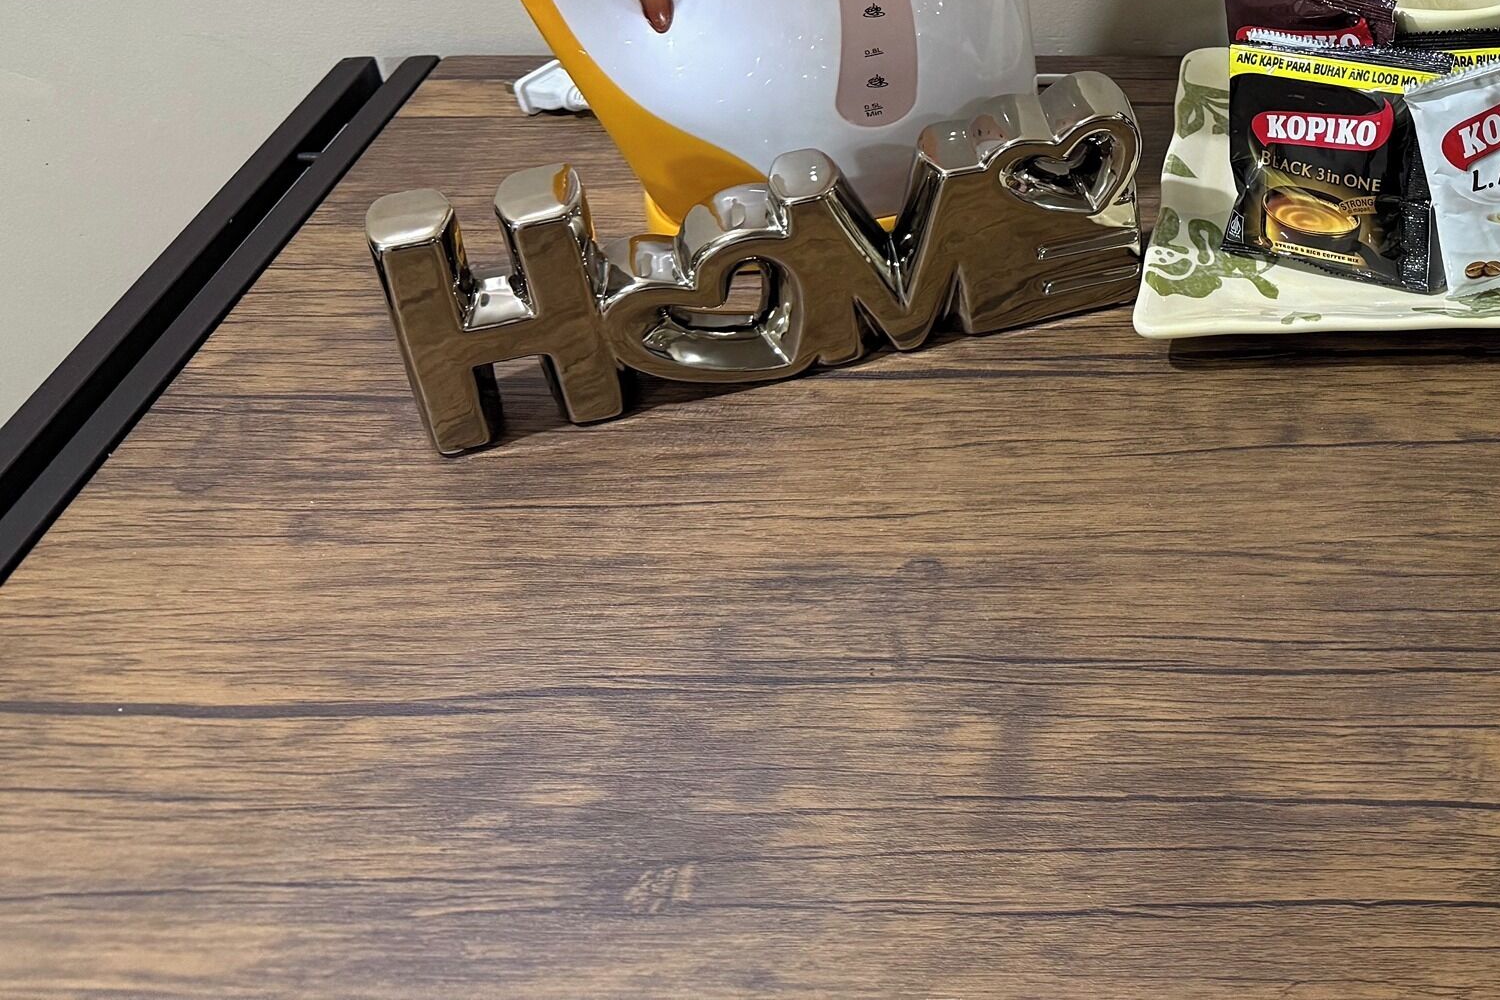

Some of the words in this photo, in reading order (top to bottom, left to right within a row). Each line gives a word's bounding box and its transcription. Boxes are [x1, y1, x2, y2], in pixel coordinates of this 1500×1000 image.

[1453, 55, 1474, 68] ARA
[1236, 52, 1259, 65] ANG
[1259, 55, 1284, 70] KAPE
[1285, 60, 1311, 73] PARA
[1313, 63, 1348, 78] BUHAY
[1349, 68, 1370, 82] ANG
[1371, 73, 1399, 86] LOOB
[866, 110, 883, 118] Min
[1266, 114, 1377, 147] KOPIKO
[1261, 150, 1313, 178] BLACK
[1343, 173, 1382, 192] ONE
[1340, 198, 1374, 211] STRONG
[1322, 251, 1346, 261] COFFEE
